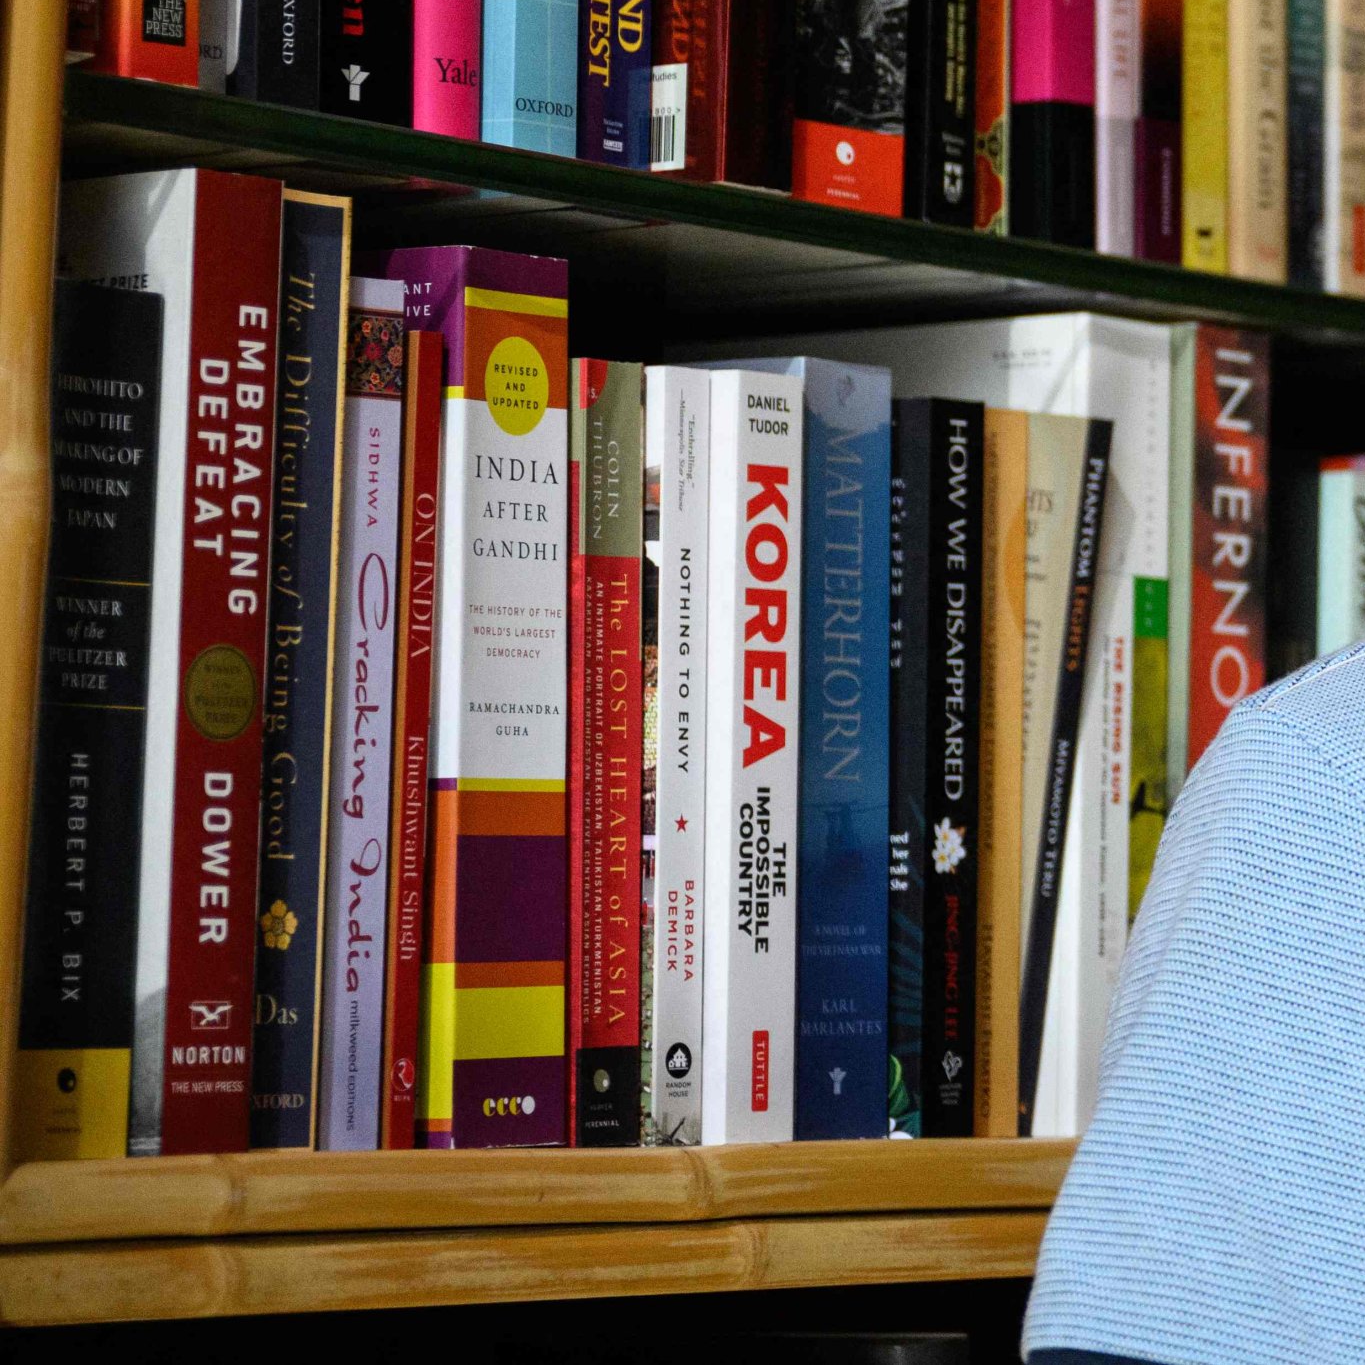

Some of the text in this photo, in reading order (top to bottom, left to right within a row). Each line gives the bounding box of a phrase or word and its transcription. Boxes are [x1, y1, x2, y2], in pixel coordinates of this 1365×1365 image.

[145, 21, 183, 38] PRESS
[151, 8, 182, 23] NEW
[433, 57, 479, 87] Yale
[515, 97, 574, 118] OXFORD
[56, 371, 144, 400] HIROHITO
[494, 363, 539, 377] REVISED
[505, 382, 526, 392] AND
[63, 407, 133, 432] AND THE
[492, 396, 540, 411] UPDATED
[747, 394, 790, 414] DANIEL
[749, 418, 789, 436] TUDOR
[53, 443, 144, 466] MAKING OF
[193, 357, 231, 557] DEFEAT
[227, 304, 269, 617] EMBRACING
[475, 455, 560, 485] INDIA
[57, 474, 131, 498] MODERN
[366, 427, 380, 527] SIDHWA
[592, 416, 603, 540] THUBRON
[606, 439, 619, 519] COLIN
[65, 507, 118, 529] JAPAN
[483, 501, 549, 523] AFTER
[1210, 349, 1254, 707] INFERNO
[266, 272, 317, 861] The Difficulty of Being Good
[473, 539, 559, 562] GANDHI
[1064, 457, 1105, 673] PHANTOM LIGHTS
[409, 492, 437, 659] ON INDIA
[55, 596, 123, 617] WINNER
[743, 464, 790, 768] KOREA
[821, 436, 863, 783] MATTERHORN
[943, 418, 969, 801] HOW WE DISAPPEARED
[48, 646, 128, 667] PULITZER
[676, 548, 692, 773] NOTHING TO ENVY
[61, 672, 109, 690] PRIZE
[469, 702, 560, 715] RAMACHANDRA
[496, 724, 529, 737] GUHA
[343, 552, 390, 993] Cracking India
[607, 573, 628, 1026] The LOST HEART of ASIA
[63, 751, 90, 893] HERBERT
[198, 770, 235, 946] DOWER
[399, 735, 426, 962] Khushwant Singh
[772, 842, 787, 897] THE
[739, 803, 754, 937] COUNTRY
[755, 787, 771, 954] IMPOSSIBLE
[667, 891, 678, 973] DEMICK
[683, 880, 694, 982] BARBARA
[59, 953, 84, 1003] BIX
[254, 992, 298, 1027] Das
[822, 998, 858, 1014] KARL
[350, 999, 361, 1072] milkweed
[800, 1021, 883, 1035] MARLANTES
[171, 1045, 247, 1065] NORTON
[754, 1040, 766, 1102] TUTTLE
